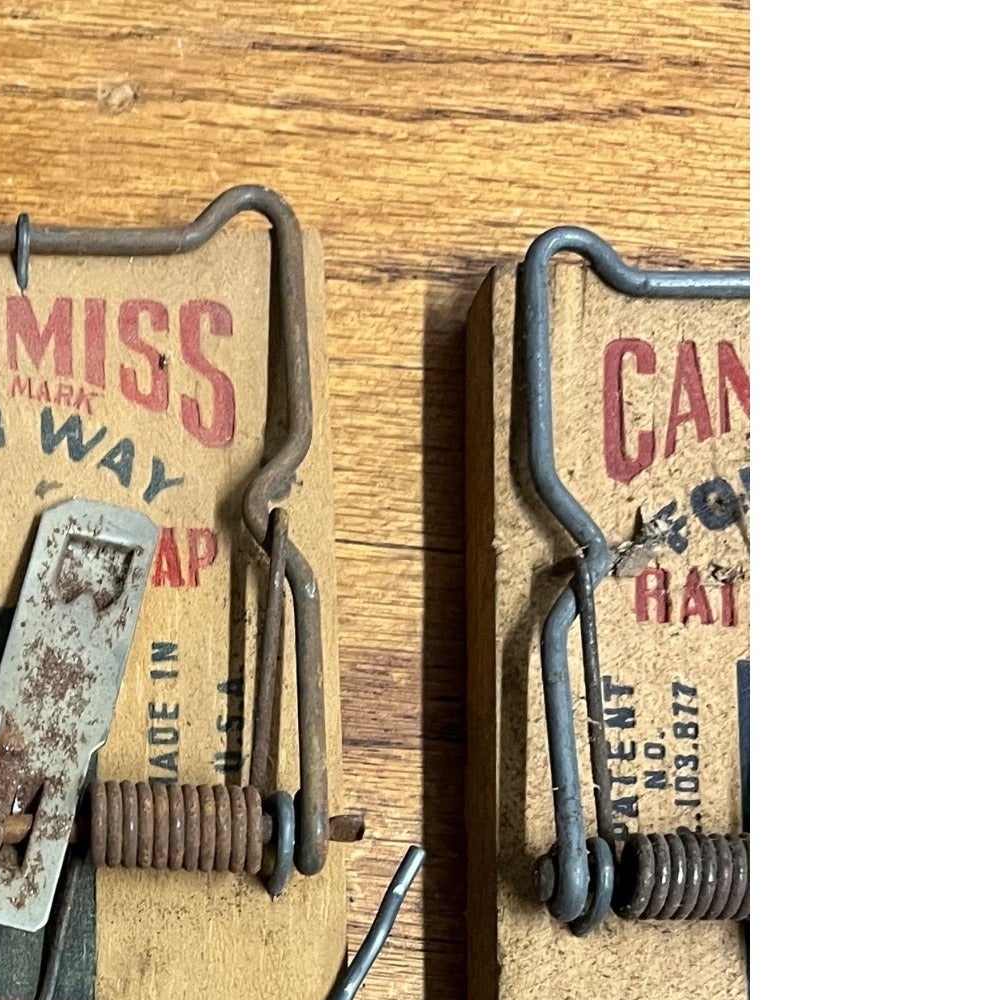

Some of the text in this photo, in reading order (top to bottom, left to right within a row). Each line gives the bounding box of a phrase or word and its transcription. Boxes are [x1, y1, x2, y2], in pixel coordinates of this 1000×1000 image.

[5, 294, 235, 449] MISS
[10, 375, 98, 414] MARK
[40, 406, 185, 504] WAY
[151, 527, 218, 588] AP
[150, 641, 179, 680] IN
[644, 730, 667, 790] NO.
